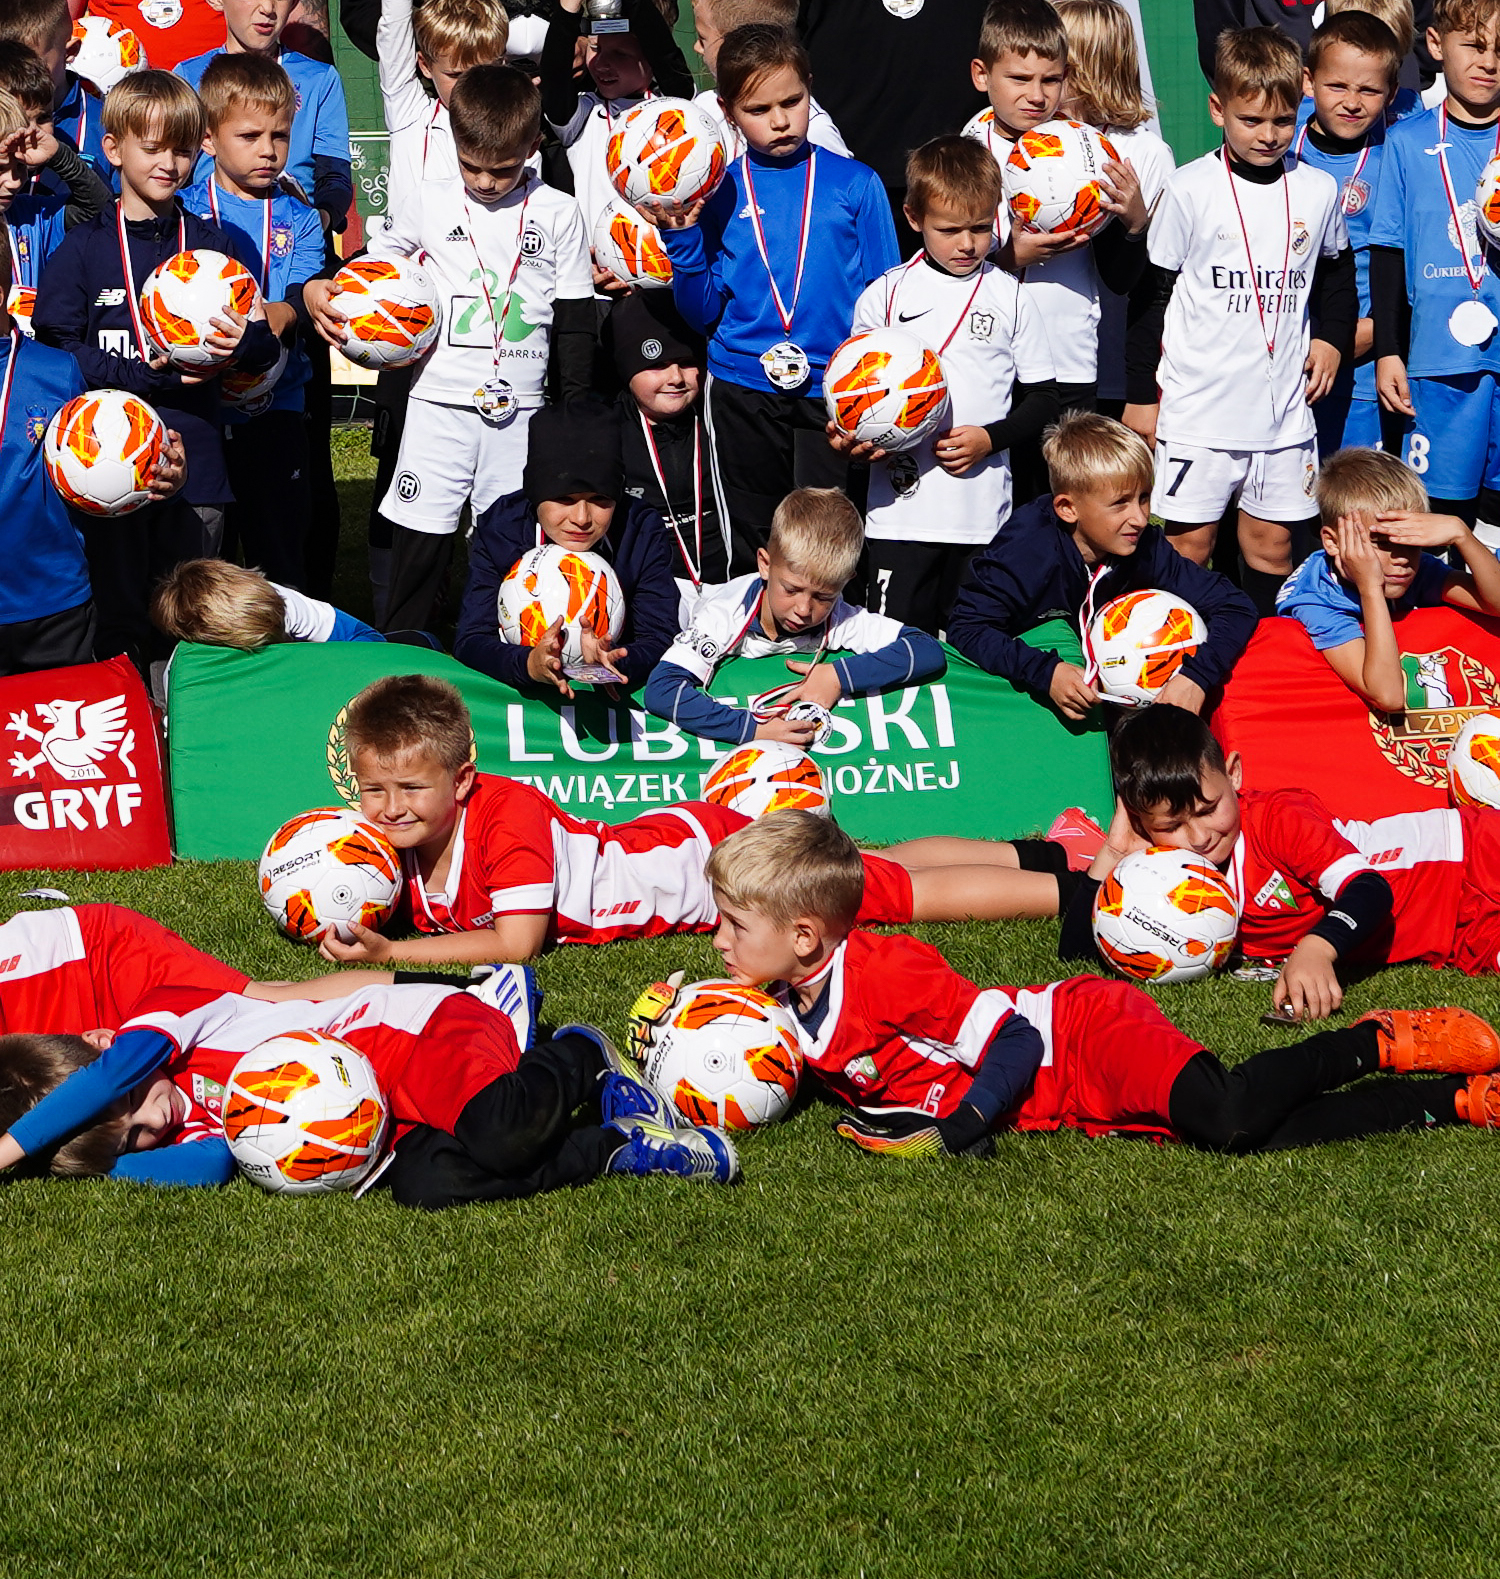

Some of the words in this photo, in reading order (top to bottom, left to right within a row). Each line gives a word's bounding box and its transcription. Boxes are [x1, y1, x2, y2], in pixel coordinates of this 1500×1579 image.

[1211, 265, 1307, 290] Emirates
[1228, 294, 1252, 313] FLY
[1258, 293, 1298, 313] BETTER
[1407, 433, 1431, 474] 8
[1168, 458, 1193, 496] 7
[878, 569, 892, 614] 7
[507, 682, 958, 763] LUBSKI
[69, 766, 97, 779] 2011
[827, 757, 961, 797] OŻNEJ
[13, 782, 143, 831] GRYF
[272, 849, 323, 879] RESORT
[1124, 911, 1180, 948] RESORT
